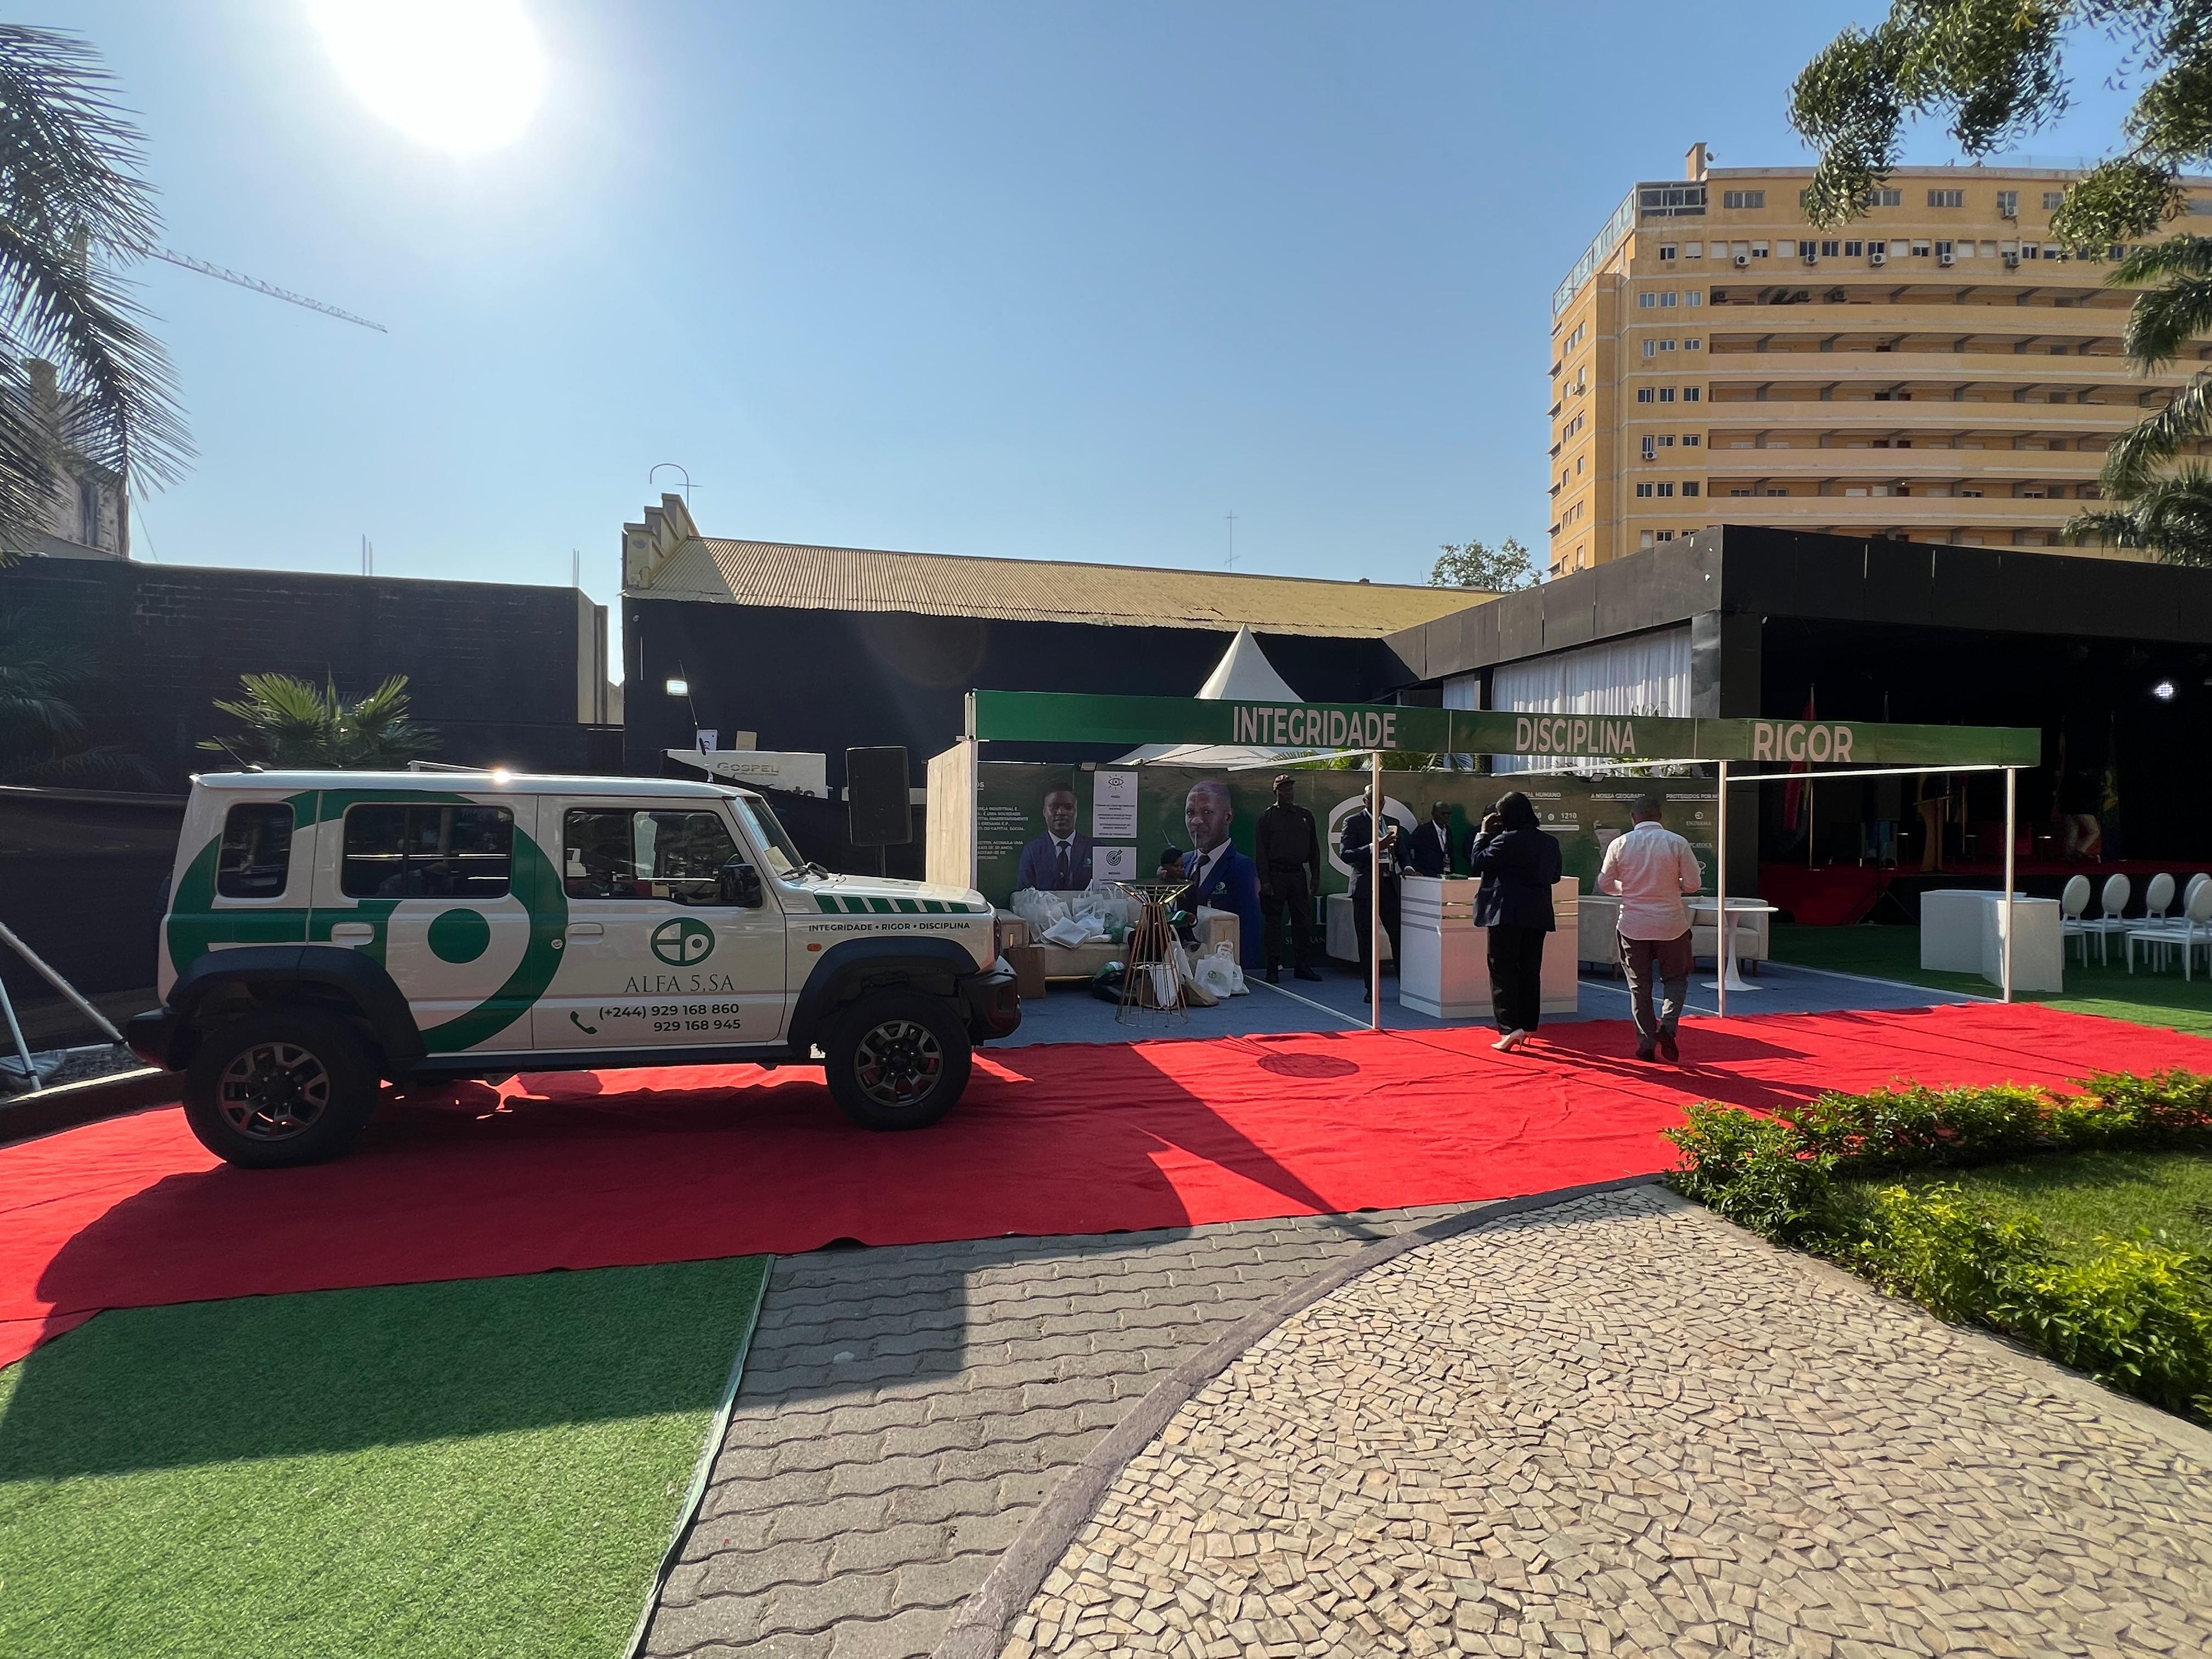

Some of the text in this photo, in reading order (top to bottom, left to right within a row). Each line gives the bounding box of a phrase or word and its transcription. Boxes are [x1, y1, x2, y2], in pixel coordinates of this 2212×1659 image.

[1233, 706, 1397, 748] INTEGRIDADE
[1516, 718, 1636, 754] DISCIPLINA
[1753, 723, 1853, 763] RIGOR
[716, 762, 779, 773] GOSPEL
[624, 975, 682, 992] ALFA
[599, 1003, 740, 1020] (+244) 929 168 860
[654, 1019, 741, 1032] 929 168 945
